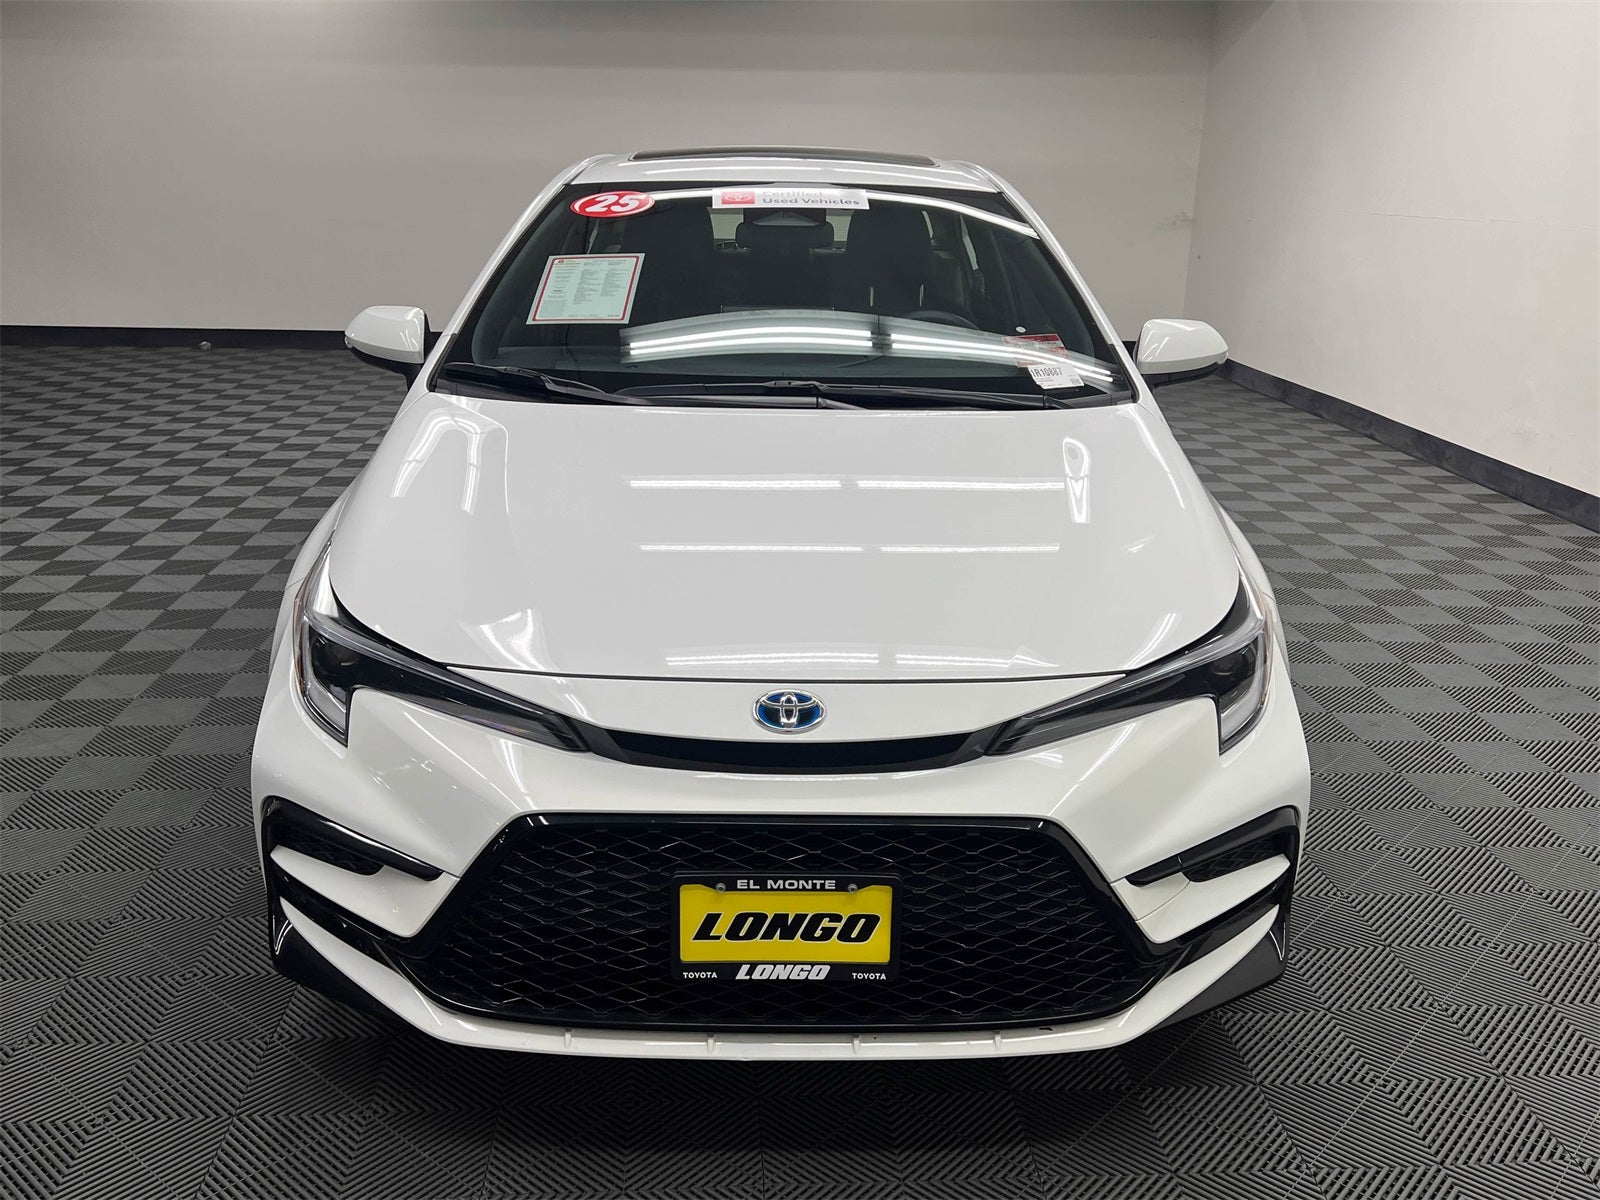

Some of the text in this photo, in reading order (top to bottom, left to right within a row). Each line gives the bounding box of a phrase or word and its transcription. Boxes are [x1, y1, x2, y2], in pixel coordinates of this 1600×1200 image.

[761, 190, 823, 199] Certified
[585, 194, 645, 213] 25
[762, 197, 860, 206] Used Vehicles
[736, 879, 836, 890] EL MONTE
[691, 911, 882, 944] LONGO
[682, 964, 887, 980] TOYOTA LONGO TOYOTA
